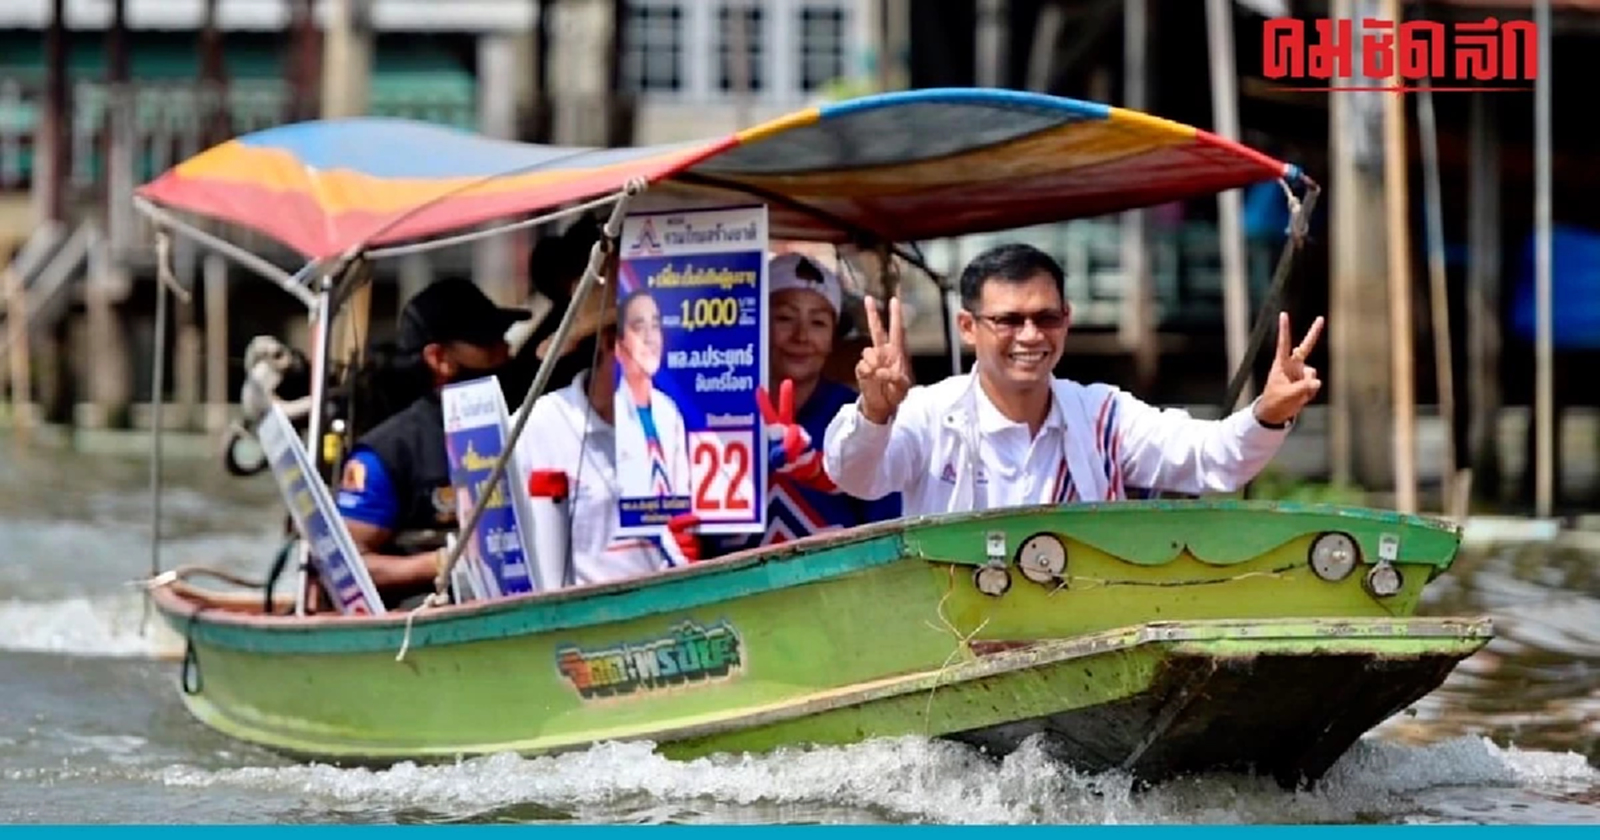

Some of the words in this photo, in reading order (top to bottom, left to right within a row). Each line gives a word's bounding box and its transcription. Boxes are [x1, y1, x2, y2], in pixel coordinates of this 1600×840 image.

[682, 298, 736, 331] 1,000
[667, 344, 754, 371] พล.อ.ประยุทธ์
[695, 372, 754, 392] จันทร์โอชา
[694, 441, 750, 510] 22
